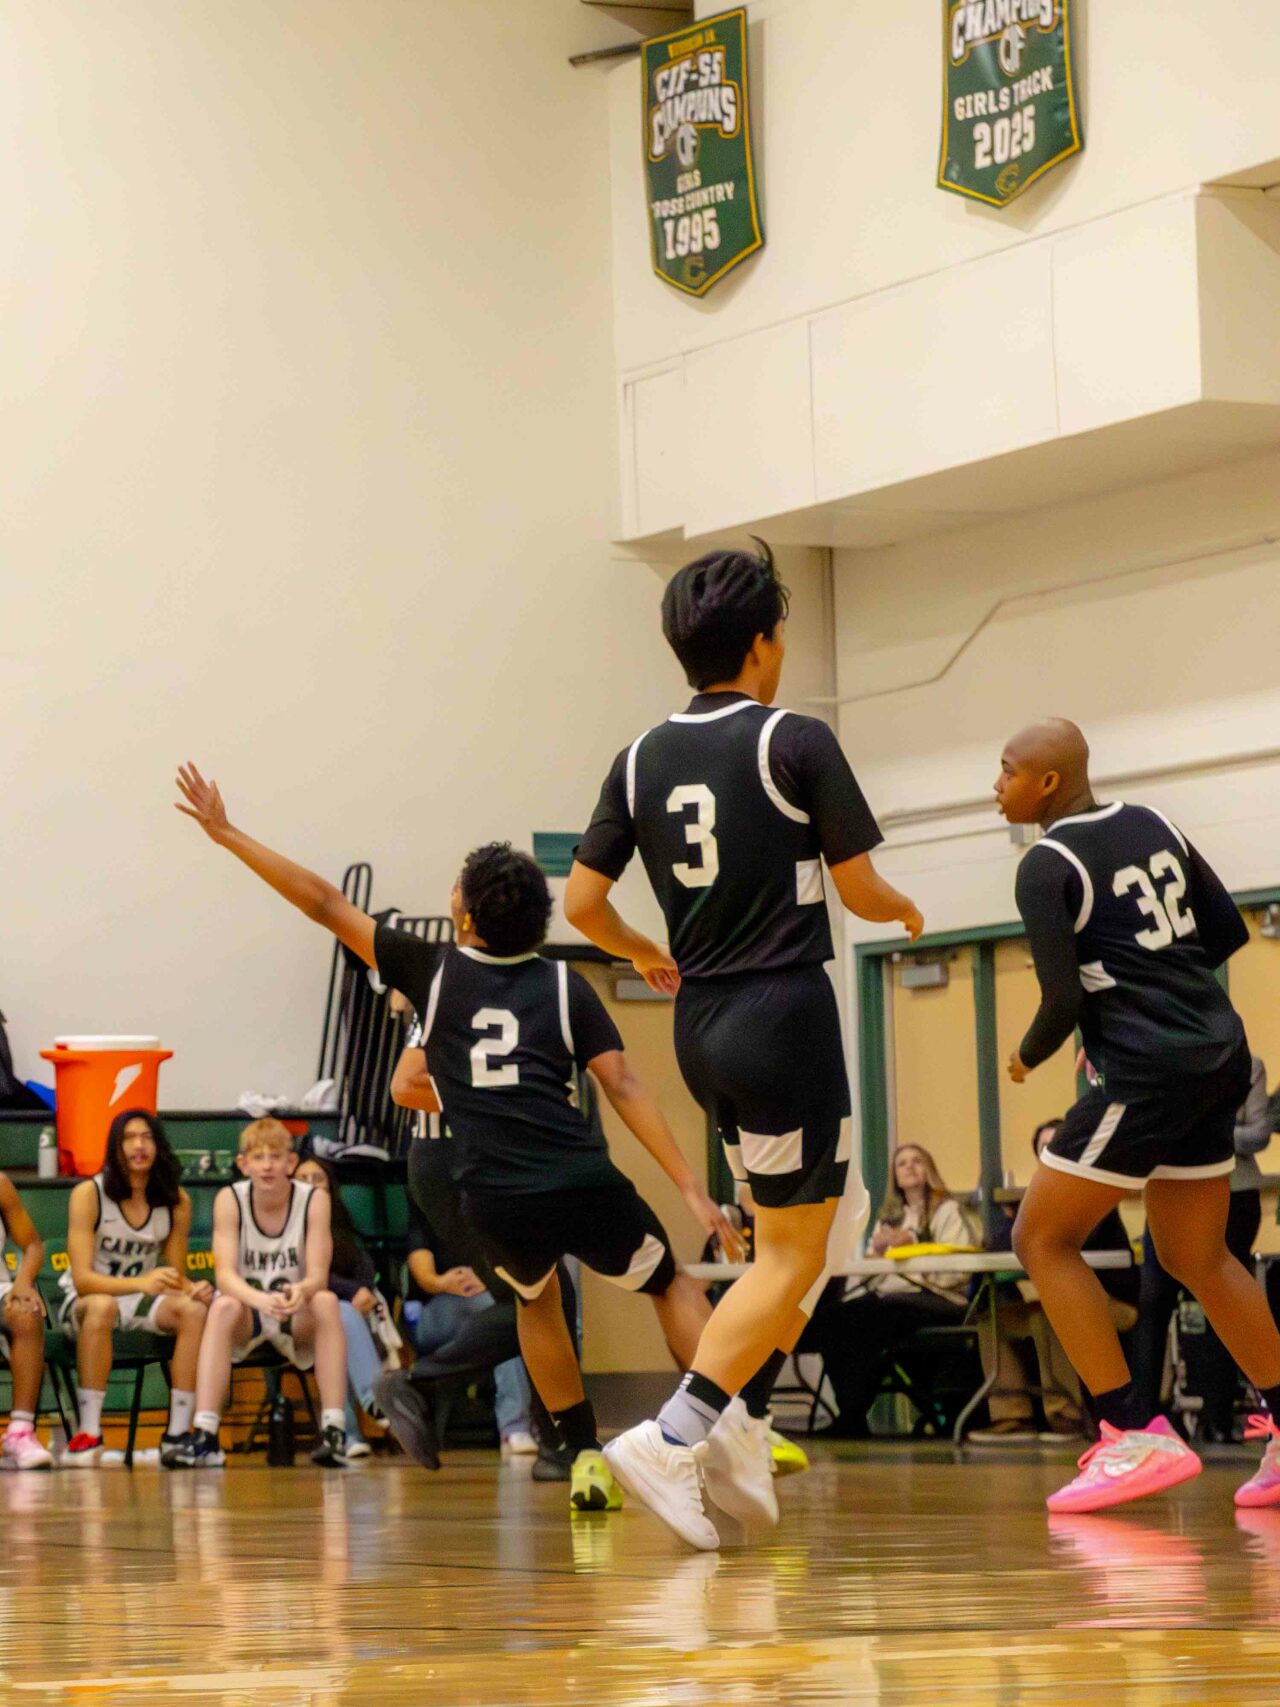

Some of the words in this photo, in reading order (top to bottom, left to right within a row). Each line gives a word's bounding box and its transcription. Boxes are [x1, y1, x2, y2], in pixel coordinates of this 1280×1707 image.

[655, 51, 724, 103] CIF-SS
[954, 87, 1011, 121] GIRLS
[1011, 65, 1054, 105] TRCK
[972, 104, 1036, 170] 2025
[651, 197, 685, 219] ROSS
[663, 207, 721, 260] 1995
[666, 783, 720, 889] 3
[1112, 849, 1198, 952] 32
[470, 1006, 520, 1089] 2
